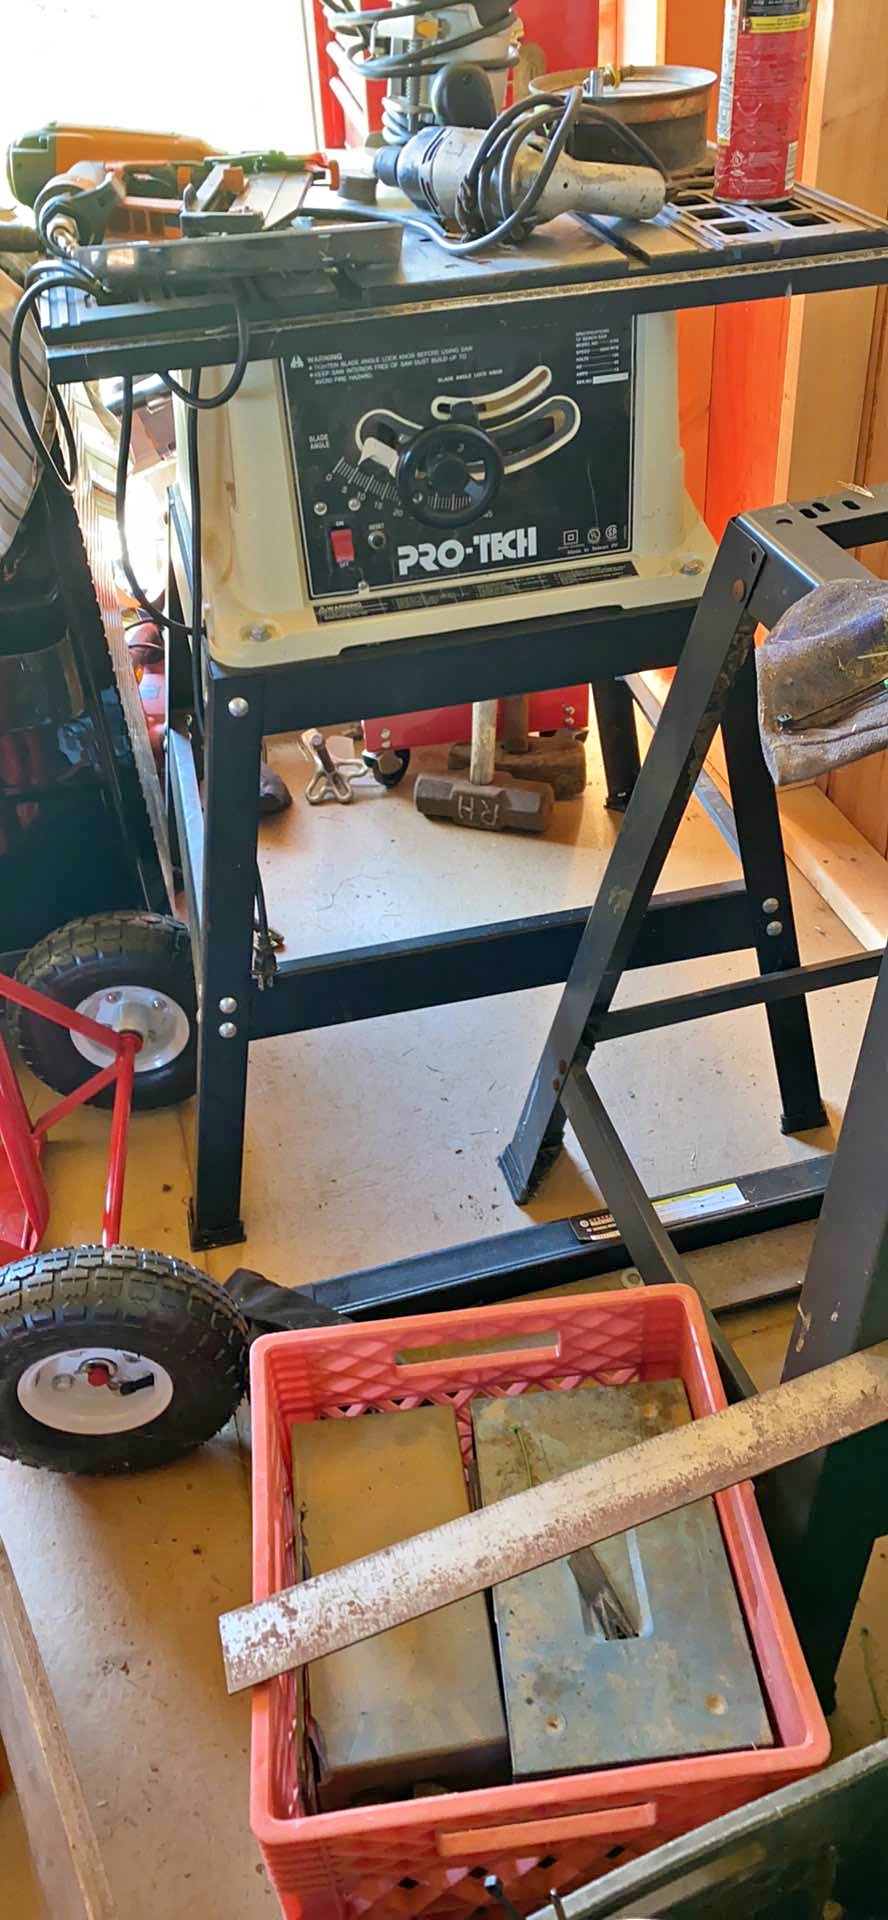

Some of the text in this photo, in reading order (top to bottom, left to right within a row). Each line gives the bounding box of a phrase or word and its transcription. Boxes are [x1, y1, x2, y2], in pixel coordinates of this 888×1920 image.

[307, 352, 343, 363] WARNING
[341, 359, 359, 368] BLADE
[360, 357, 380, 365] ANGLE
[382, 355, 397, 363] LOCK
[374, 363, 389, 371] FREE
[414, 358, 430, 366] DUST
[308, 433, 328, 442] BLADE
[310, 442, 330, 450] ANGLE
[397, 526, 538, 576] PRO-TECH
[458, 795, 499, 826] RH
